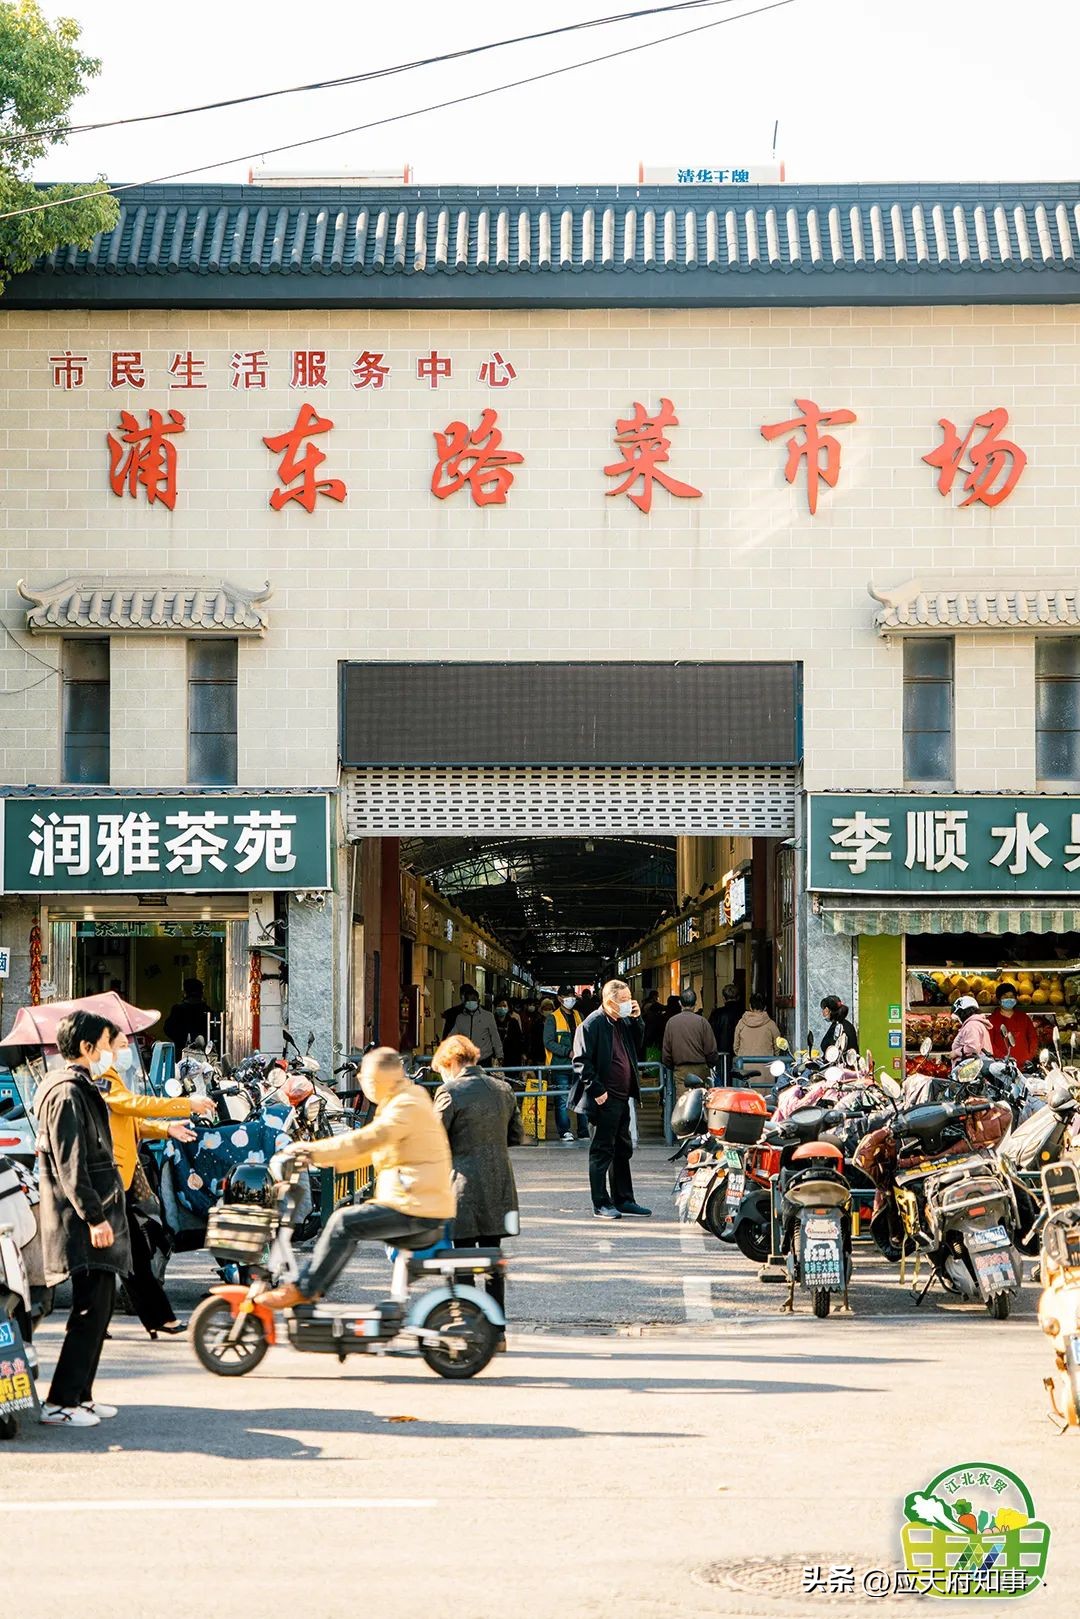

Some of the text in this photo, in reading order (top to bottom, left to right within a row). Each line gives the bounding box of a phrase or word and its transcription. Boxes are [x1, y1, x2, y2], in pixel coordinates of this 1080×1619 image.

[50, 351, 517, 389] 市民生活服务中心
[106, 398, 1028, 514] 浦东路菜市场
[28, 810, 297, 876] 润雅茶苑
[829, 811, 1080, 874] 李顺水
